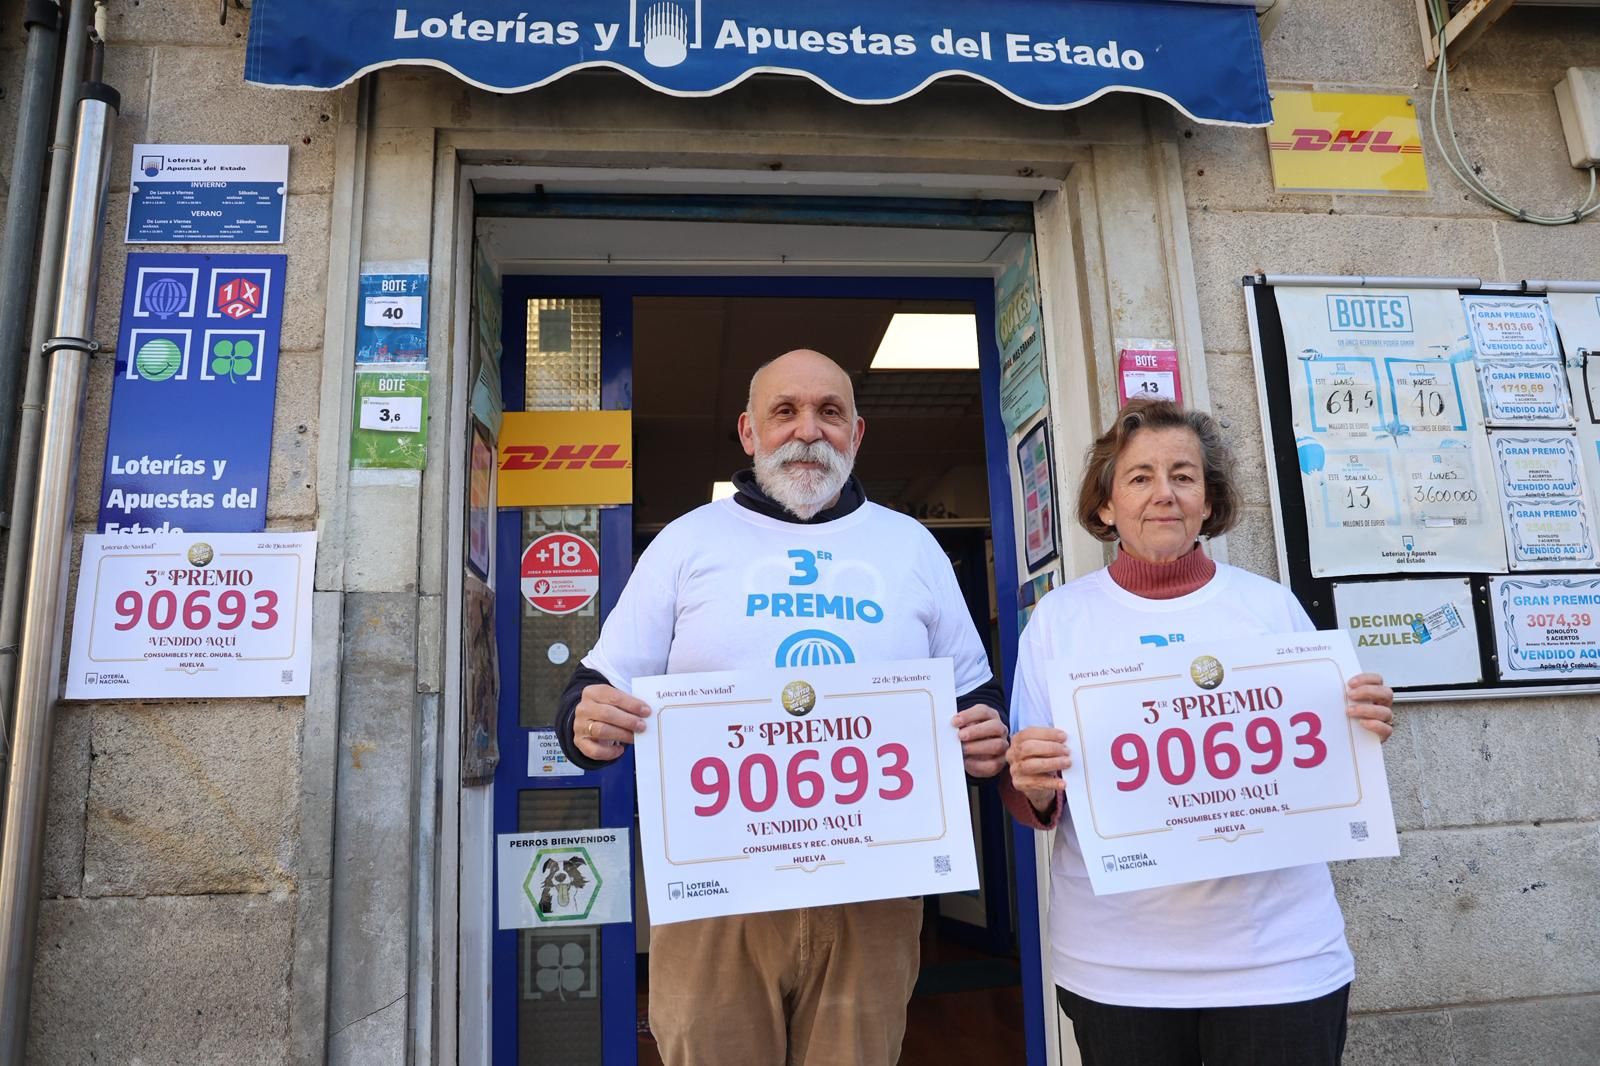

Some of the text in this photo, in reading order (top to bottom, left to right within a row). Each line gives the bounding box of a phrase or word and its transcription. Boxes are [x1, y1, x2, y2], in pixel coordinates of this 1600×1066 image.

[394, 9, 1144, 71] Loterías y Apuestas del Estado
[1292, 128, 1402, 153] DHL
[382, 279, 407, 291] BOTE
[382, 307, 403, 320] 40
[1335, 298, 1404, 329] BOTES
[1478, 311, 1536, 319] GRAN PREMIO
[1135, 355, 1158, 367] BOTE
[379, 378, 406, 391] BOTE
[1141, 381, 1159, 393] 13
[379, 408, 401, 423] 3,6
[501, 444, 628, 470] DHL
[1505, 447, 1566, 455] GRAN PREMIO
[111, 454, 227, 480] Loterías y
[1429, 470, 1457, 481] LUNES
[1512, 483, 1550, 491] VENDIDO
[106, 488, 257, 514] Apuestas del
[1346, 485, 1371, 509] 13
[1516, 510, 1541, 518] GRAN
[1342, 520, 1365, 528] MILLONES
[1371, 519, 1385, 527] EUROS
[536, 541, 581, 567] +18
[1411, 550, 1437, 558] Apuestas
[168, 569, 253, 587] PREMIO
[1513, 595, 1550, 606] GRAN
[114, 589, 279, 631] 90693
[746, 593, 884, 624] PREMIO
[1349, 612, 1424, 629] DECIMOS
[1526, 613, 1592, 628] 3074,39
[149, 634, 237, 648] VENDIDO AQUÍ
[1357, 631, 1422, 648] AZULES
[1520, 649, 1575, 661] VENDIDO
[872, 676, 880, 684] 22
[1172, 686, 1283, 721] PREMIO
[759, 715, 872, 746] PREMIO
[1110, 712, 1328, 792] 90693
[690, 742, 914, 817] 90693
[1168, 779, 1279, 809] VENDIDO AQUÍ
[1166, 813, 1222, 827] CONSUMIBLES
[1230, 810, 1249, 818] REC.
[1281, 804, 1291, 812] SL
[746, 810, 863, 836] VENDIDO AQUÍ
[1214, 824, 1246, 834] HUELVA
[509, 834, 616, 848] PERROS BIENVENIDOS
[743, 841, 802, 854] CONSUMIBLES
[804, 841, 809, 849] Y
[811, 839, 829, 848] REC.
[864, 835, 874, 843] SL
[793, 854, 826, 864] HUELVA
[1118, 851, 1149, 863] LOTERÍA
[1120, 859, 1158, 871] NACIONAL
[686, 880, 720, 890] LOTERÍA
[687, 887, 730, 898] NACIONAL
